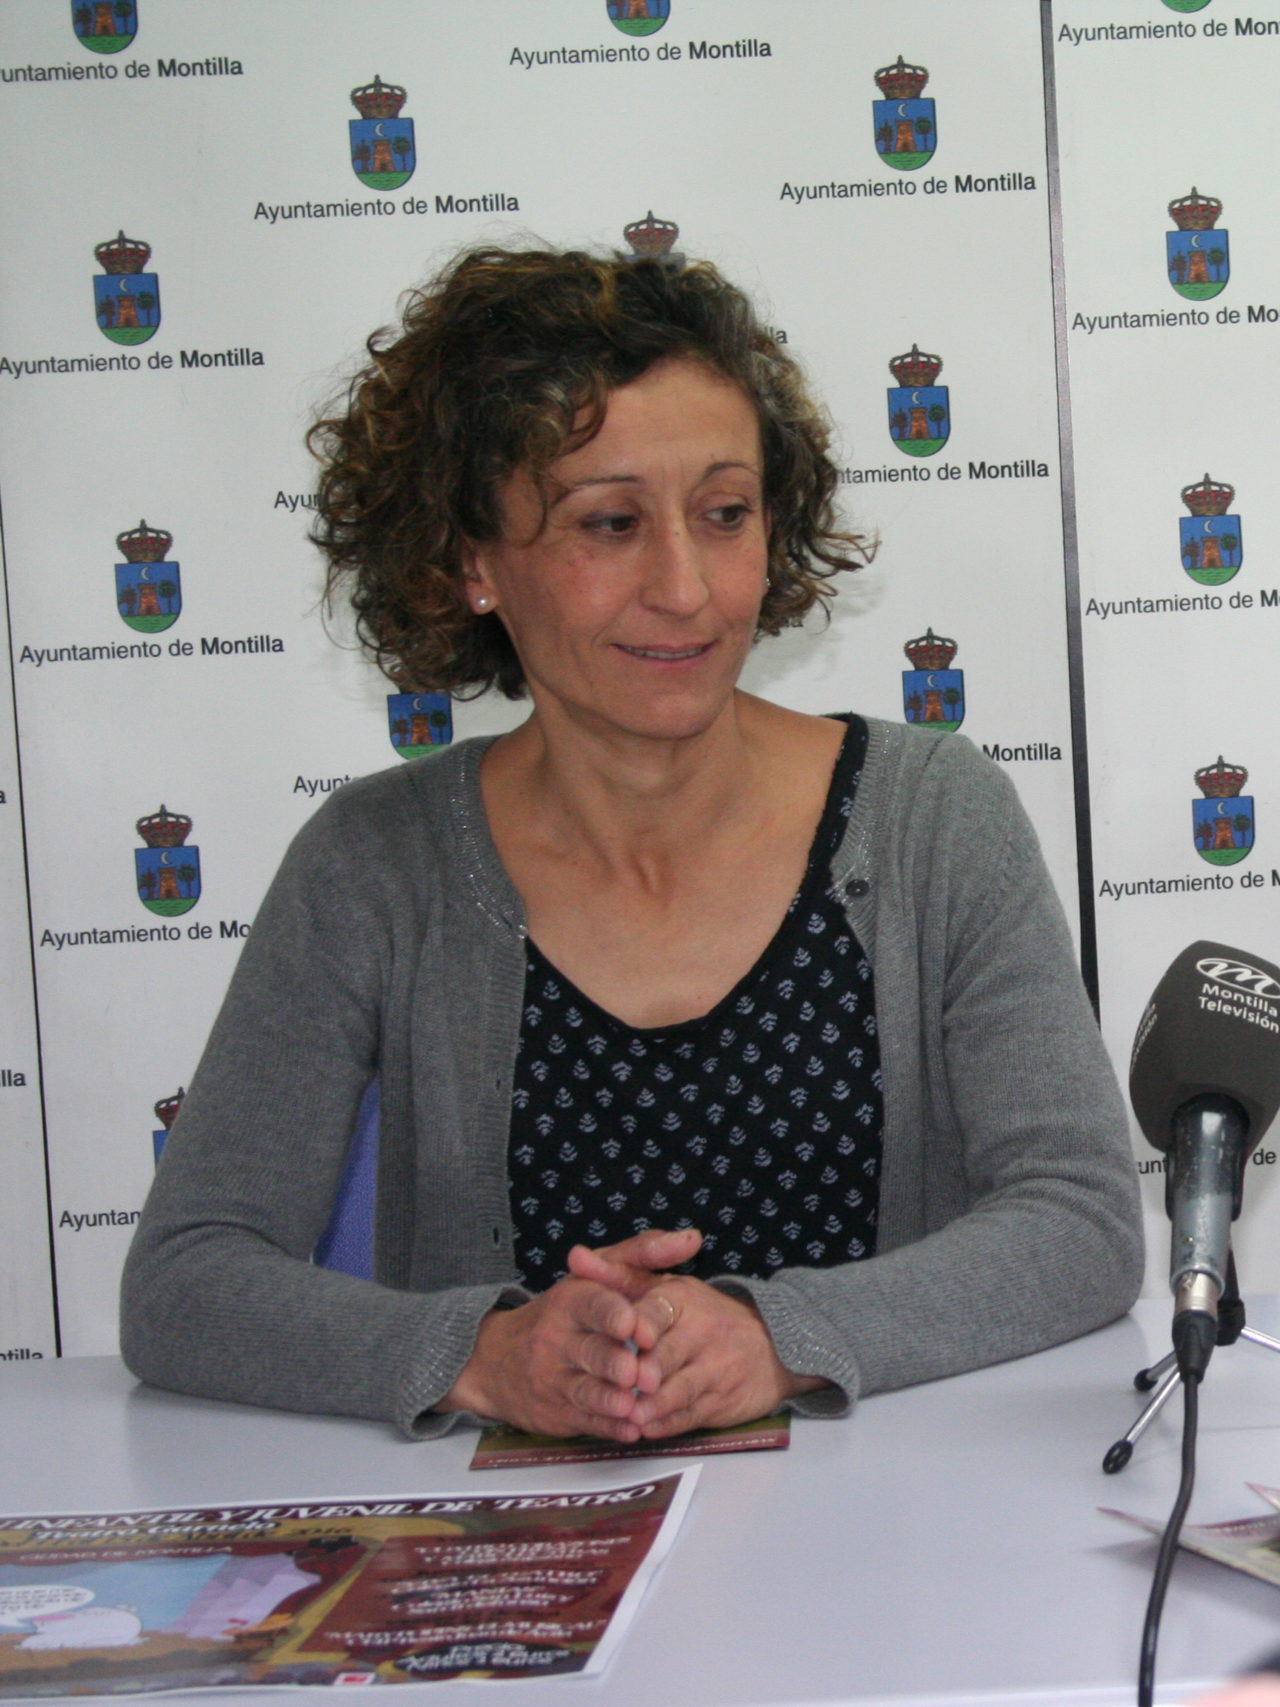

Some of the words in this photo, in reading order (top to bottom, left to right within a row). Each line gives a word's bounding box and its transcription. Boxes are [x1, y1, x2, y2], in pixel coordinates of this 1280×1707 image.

[1057, 20, 1197, 47] Ayuntamiento
[1202, 18, 1228, 38] de
[509, 44, 650, 70] Ayuntamiento
[656, 42, 682, 61] de
[688, 39, 773, 60] Montilla
[0, 61, 119, 84] untamiento
[124, 59, 151, 79] de
[156, 56, 244, 78] Montilla
[779, 177, 917, 205] Ayuntamiento
[922, 176, 948, 195] de
[954, 171, 1037, 194] Montilla
[253, 197, 396, 225] Ayuntamiento
[402, 196, 428, 215] de
[434, 192, 521, 214] Montilla
[1071, 308, 1210, 335] Ayuntamiento
[1215, 306, 1241, 325] de
[0, 352, 141, 380] Ayuntamiento
[147, 351, 174, 370] de
[179, 347, 265, 369] Montilla
[834, 461, 931, 489] ntamiento
[936, 462, 962, 481] de
[968, 459, 1050, 480] Montilla
[1085, 592, 1223, 619] Ayuntamiento
[1228, 591, 1254, 610] de
[19, 639, 162, 668] Ayuntamiento
[167, 638, 194, 657] de
[200, 634, 285, 656] Montilla
[982, 742, 1063, 762] Montilla
[1098, 873, 1234, 901] Ayuntamiento
[1239, 870, 1265, 889] de
[39, 924, 182, 951] Ayuntamiento
[187, 921, 213, 941] de
[1198, 996, 1280, 1034] Televisión
[1202, 983, 1278, 1018] Montilla
[1251, 1149, 1278, 1166] de
[13, 1511, 206, 1530] INFANTIL
[244, 1503, 415, 1521] JUVENIL
[418, 1500, 482, 1514] DE
[493, 1485, 656, 1511] TEATRO
[34, 1527, 140, 1540] Teatro
